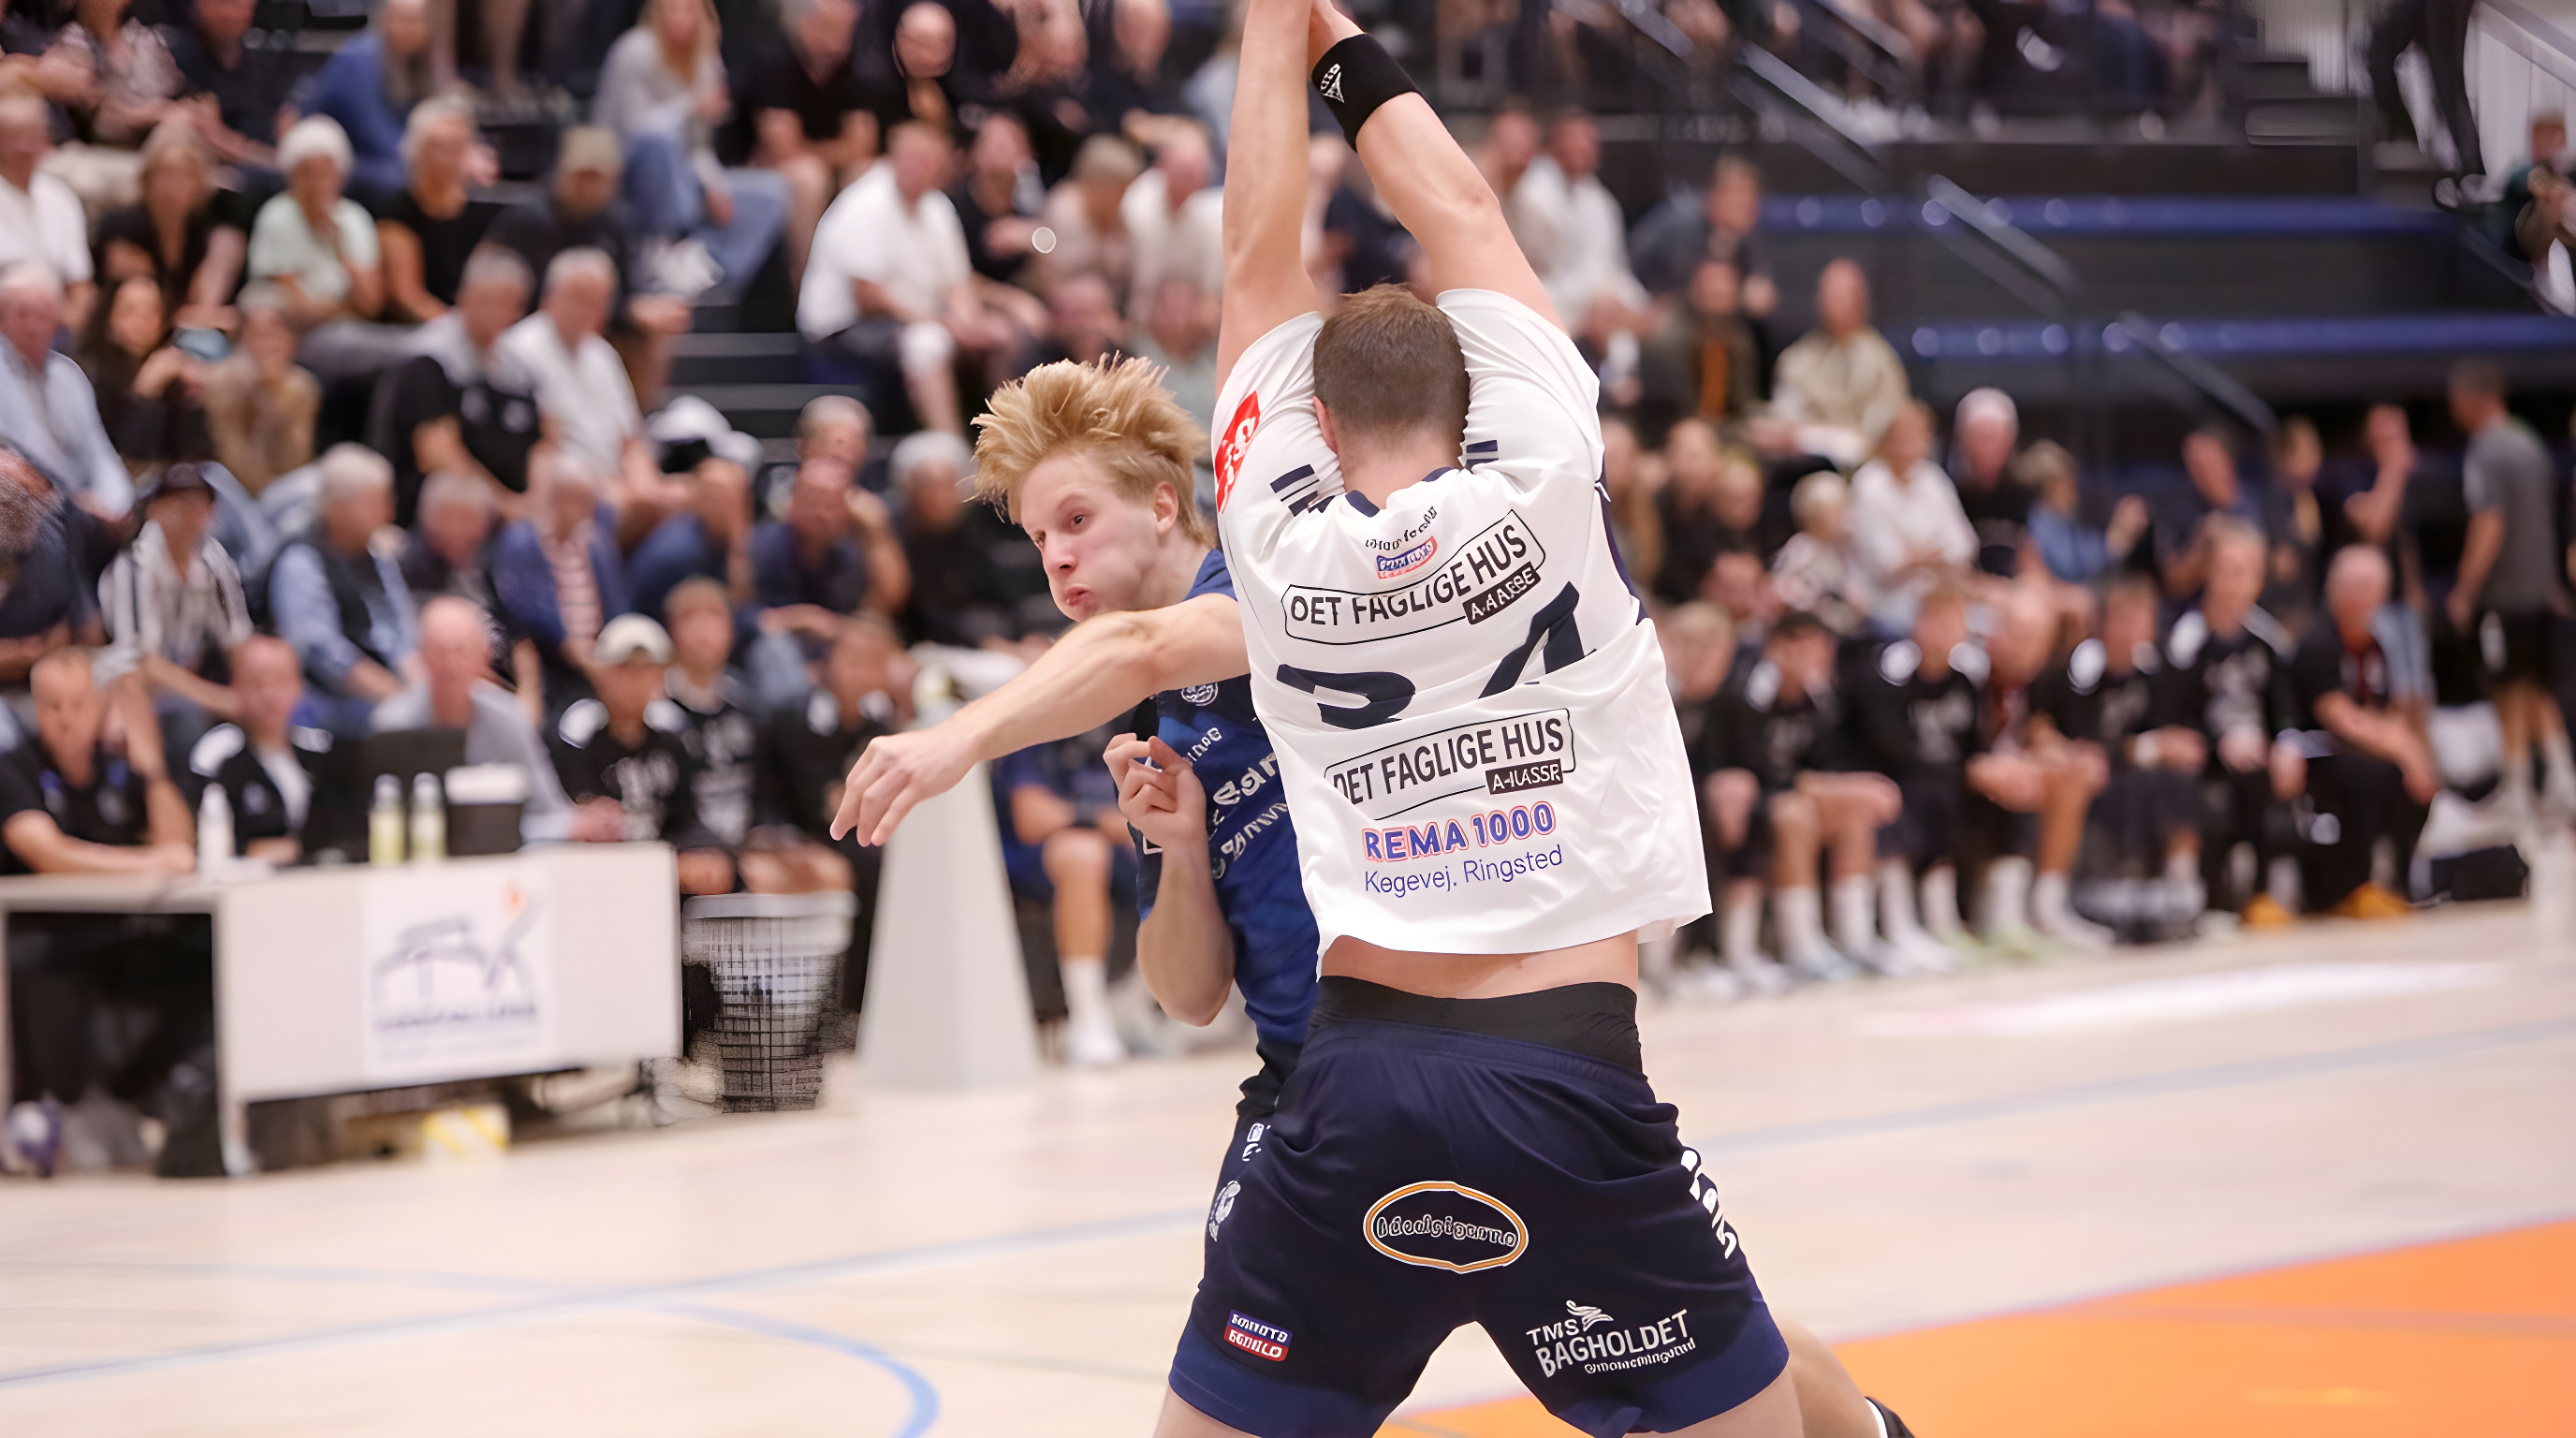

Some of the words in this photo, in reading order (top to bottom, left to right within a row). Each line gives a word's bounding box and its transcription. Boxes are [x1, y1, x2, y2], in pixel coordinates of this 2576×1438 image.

[1352, 561, 1471, 624] FAGLIGE
[1466, 524, 1527, 585] HUS
[1381, 729, 1497, 795] FAGLIGE
[1501, 718, 1564, 760] HUS
[1362, 818, 1470, 862] REMA
[1471, 800, 1557, 848] 1000
[1463, 844, 1563, 883] Ringsted
[1526, 1318, 1580, 1345] TMS
[1535, 1308, 1688, 1378] BAGHOLDET
